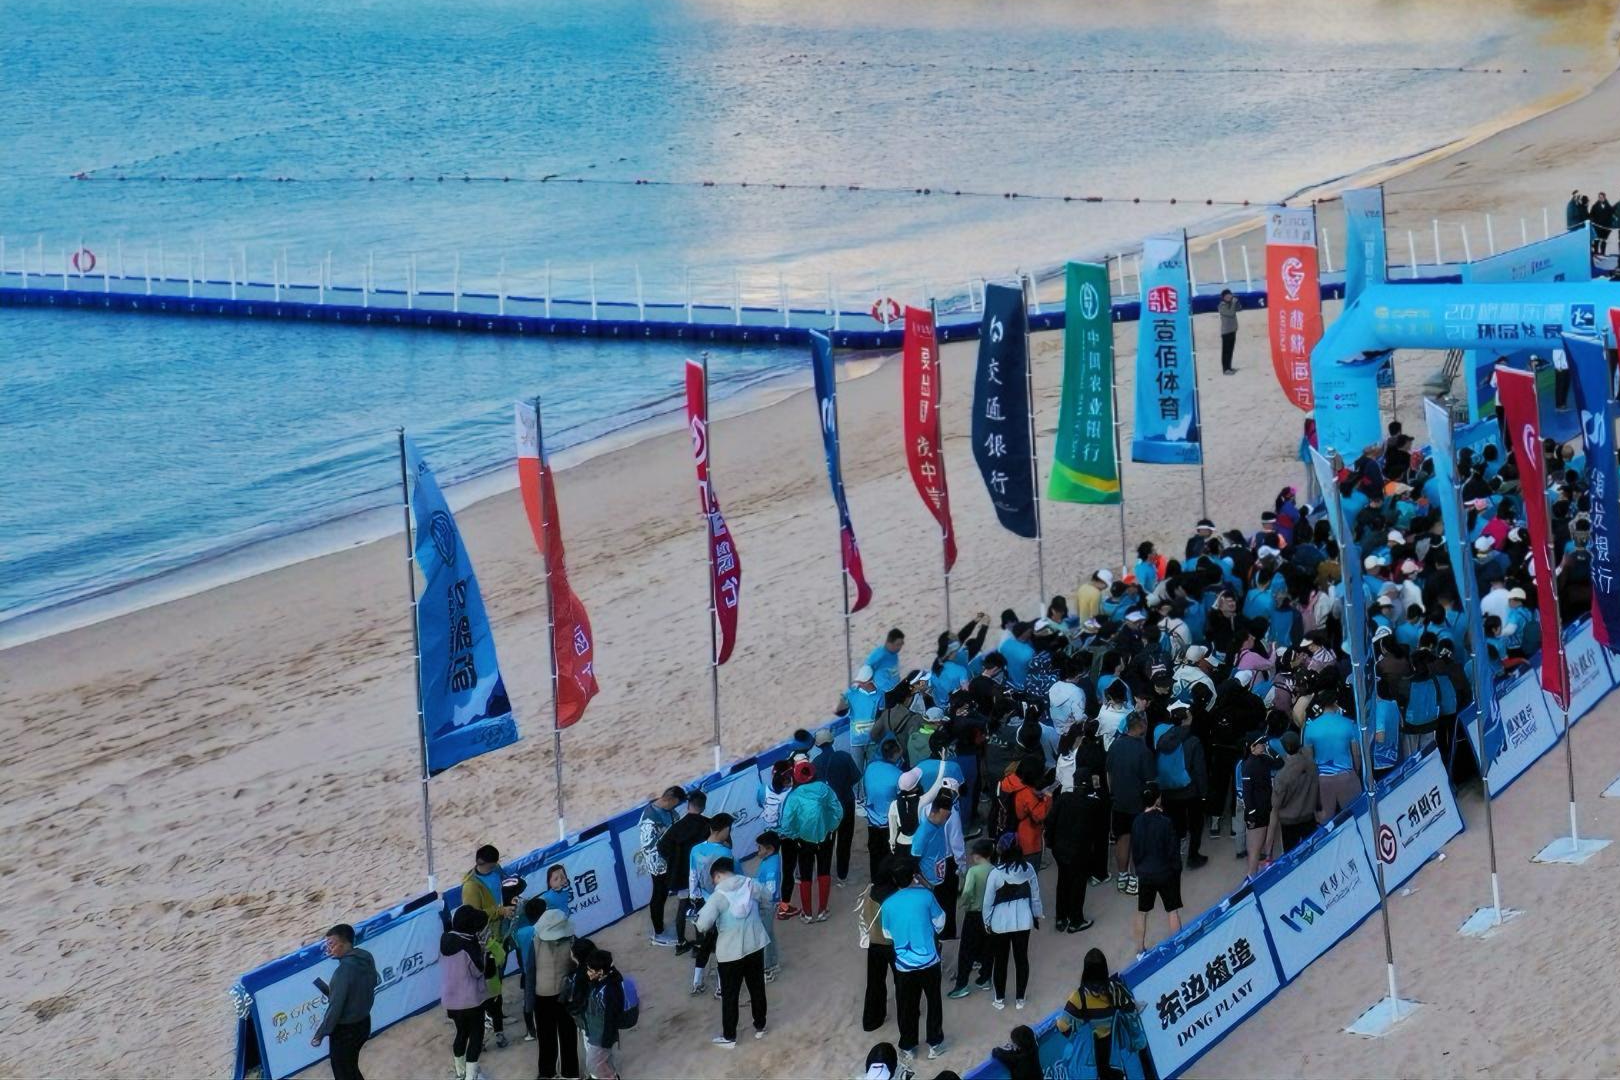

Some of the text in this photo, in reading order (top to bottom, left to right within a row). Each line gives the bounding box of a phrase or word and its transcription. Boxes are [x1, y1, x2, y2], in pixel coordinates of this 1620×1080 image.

[1153, 318, 1180, 420] 壹佰体育
[1177, 979, 1255, 1048] DONG PLANT
